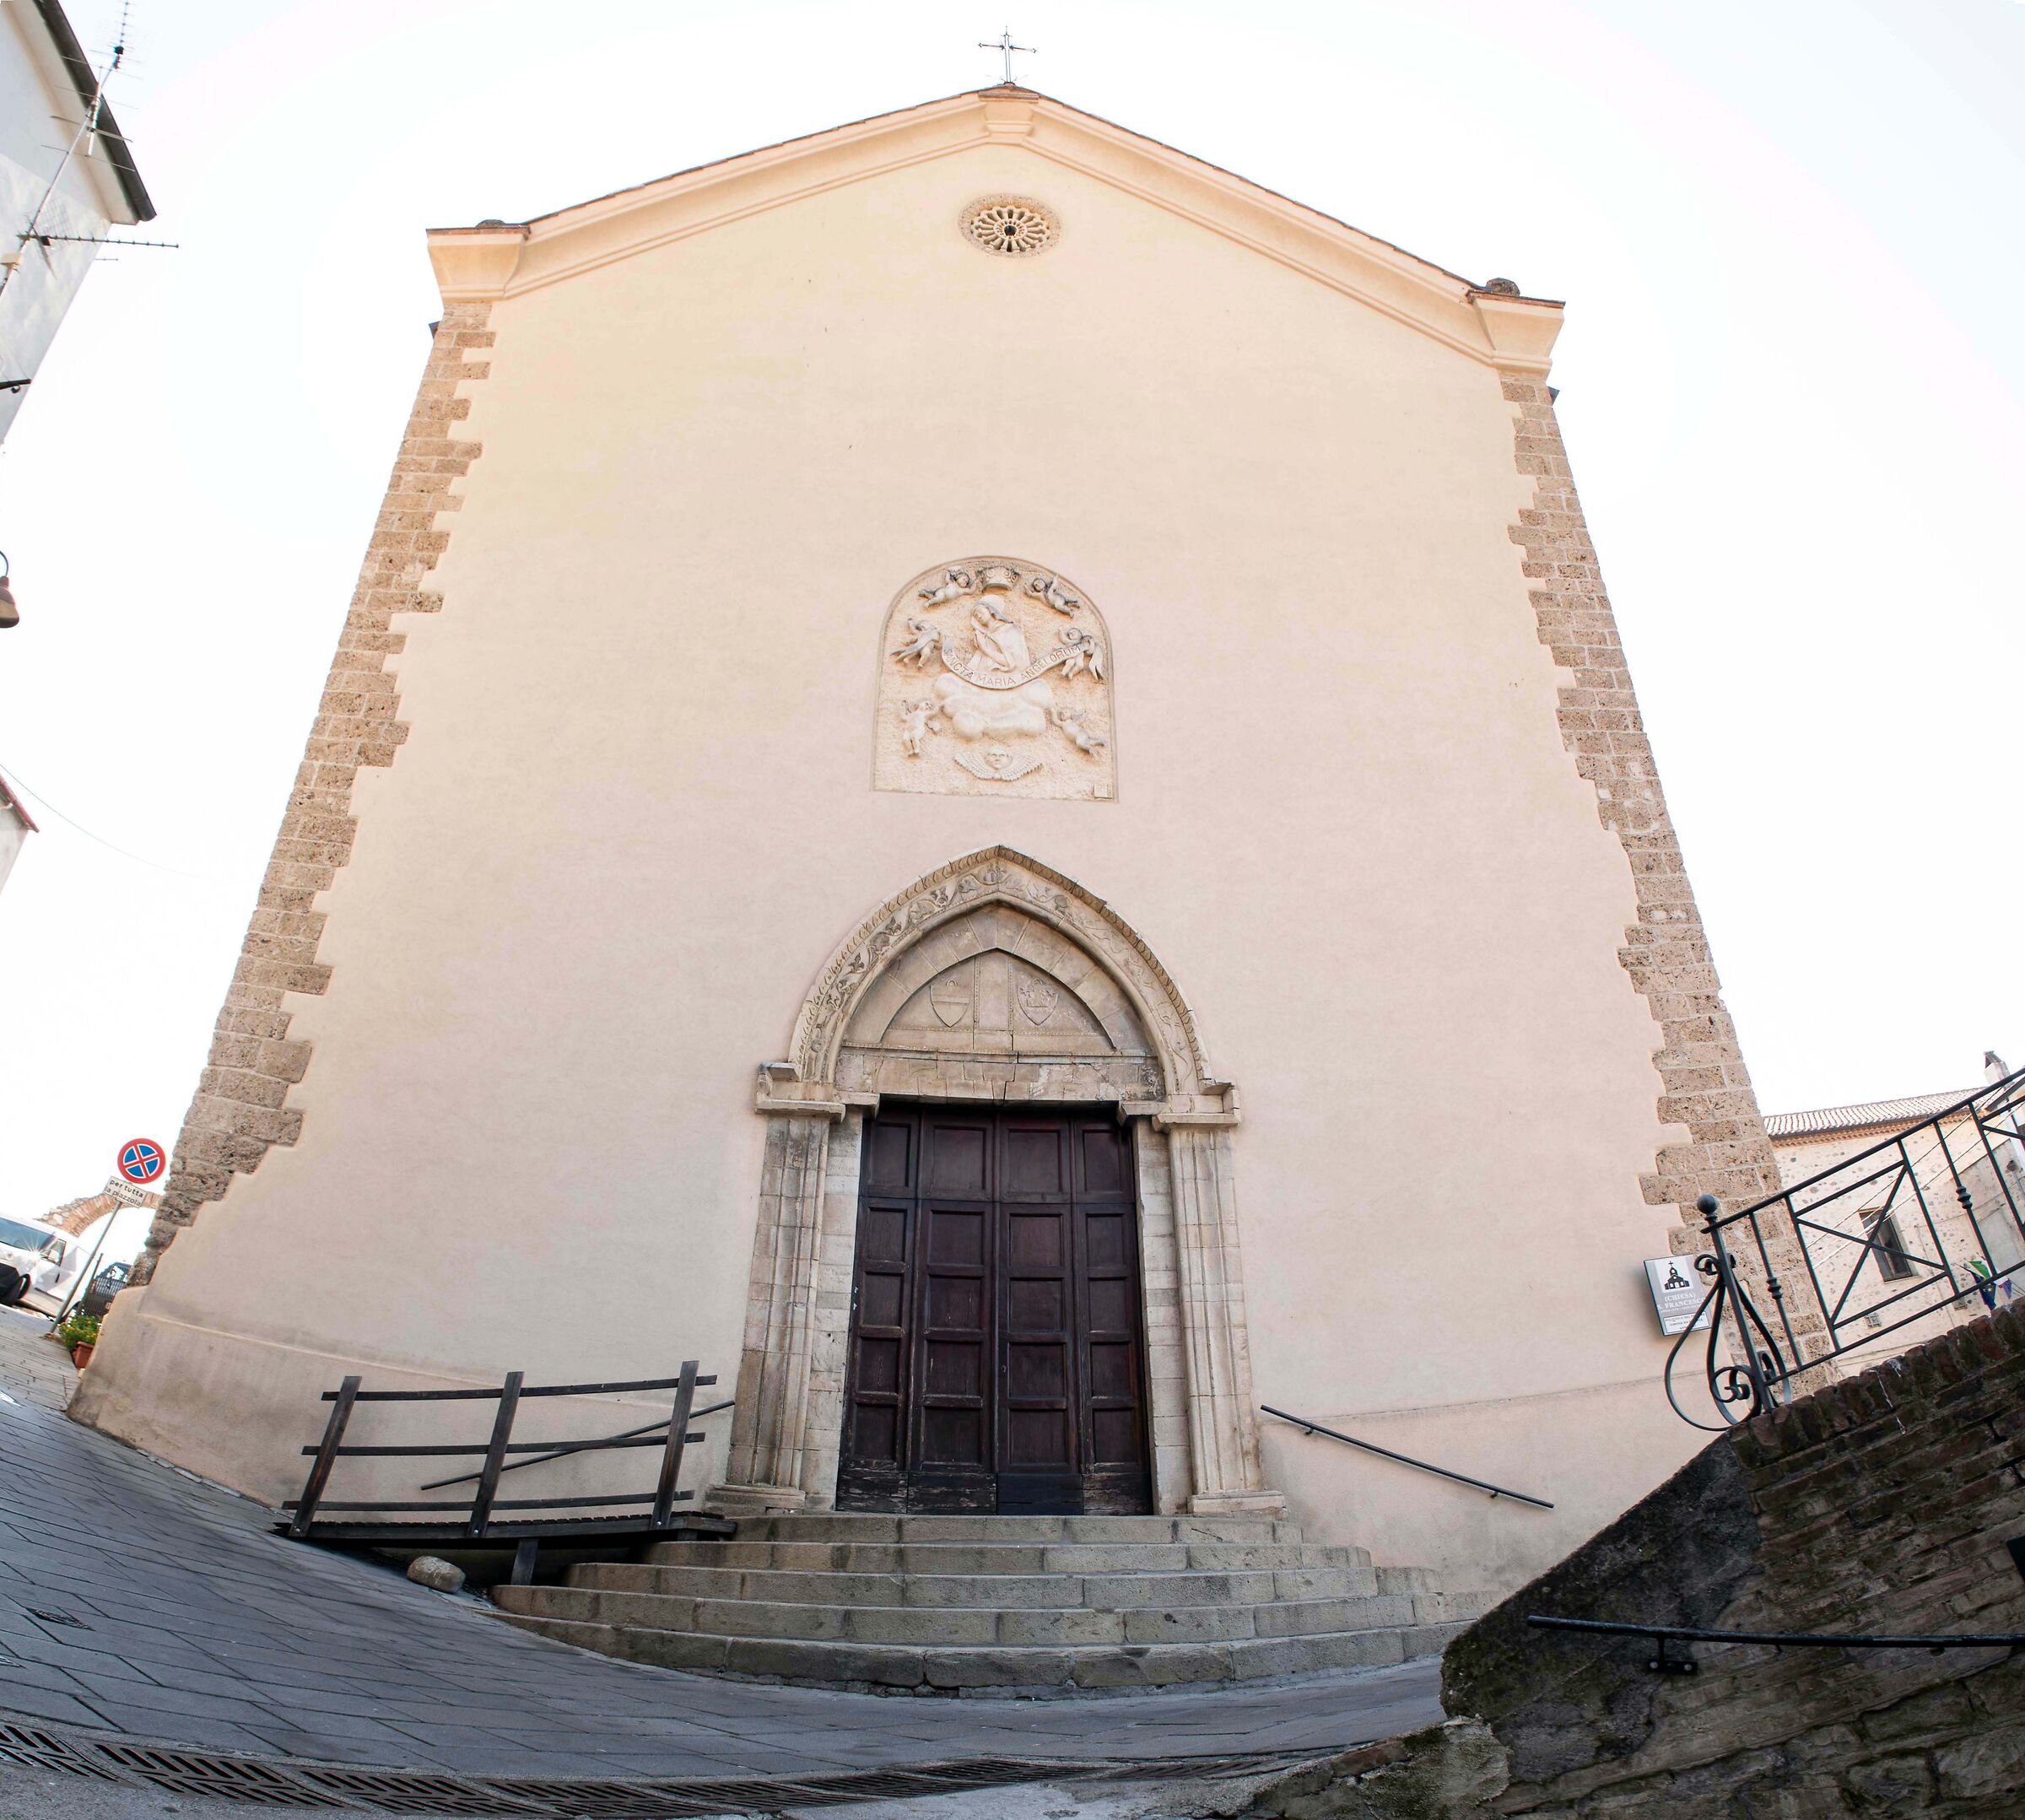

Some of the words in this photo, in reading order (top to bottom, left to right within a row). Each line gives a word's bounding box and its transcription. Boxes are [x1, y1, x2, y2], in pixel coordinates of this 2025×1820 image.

[943, 648, 974, 680] SANCTA
[975, 674, 1017, 687] MARIA
[1020, 645, 1081, 680] ANGELORUM
[110, 1180, 123, 1188] per
[124, 1185, 143, 1198] tutta
[112, 1191, 142, 1207] piazzola
